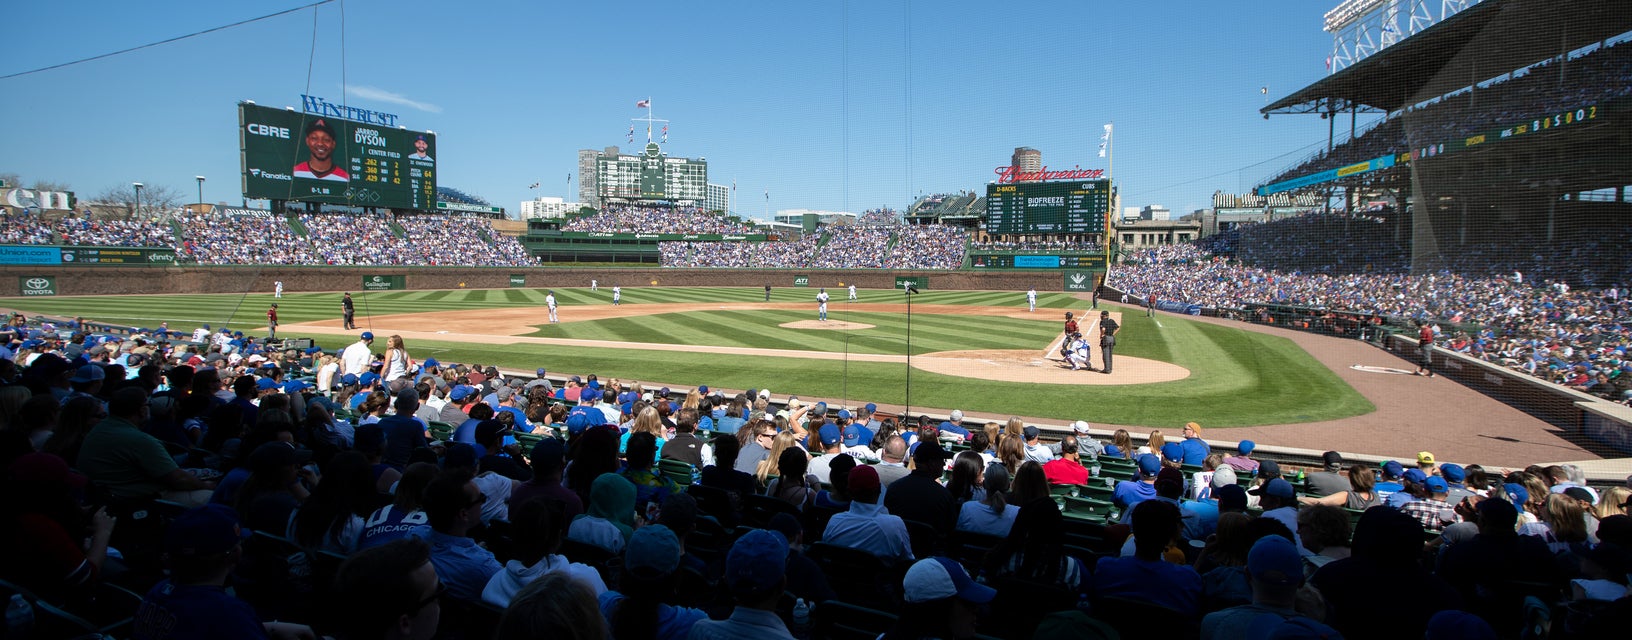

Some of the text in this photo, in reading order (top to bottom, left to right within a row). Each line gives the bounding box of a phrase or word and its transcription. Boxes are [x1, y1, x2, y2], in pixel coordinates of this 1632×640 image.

[300, 94, 398, 126] WINTRUST
[1532, 119, 1540, 132] B
[1543, 117, 1551, 128] 0
[1554, 114, 1561, 126] S
[1565, 112, 1573, 124] 0
[1589, 107, 1597, 119] 2
[247, 123, 290, 139] CBRE
[355, 128, 379, 137] JARROD
[355, 134, 386, 147] DYSON
[368, 149, 386, 157] CENTER
[261, 170, 292, 181] Fanatics
[995, 165, 1104, 184] Budweiser
[148, 253, 174, 262] xfinity
[366, 524, 414, 538] CHICAGO
